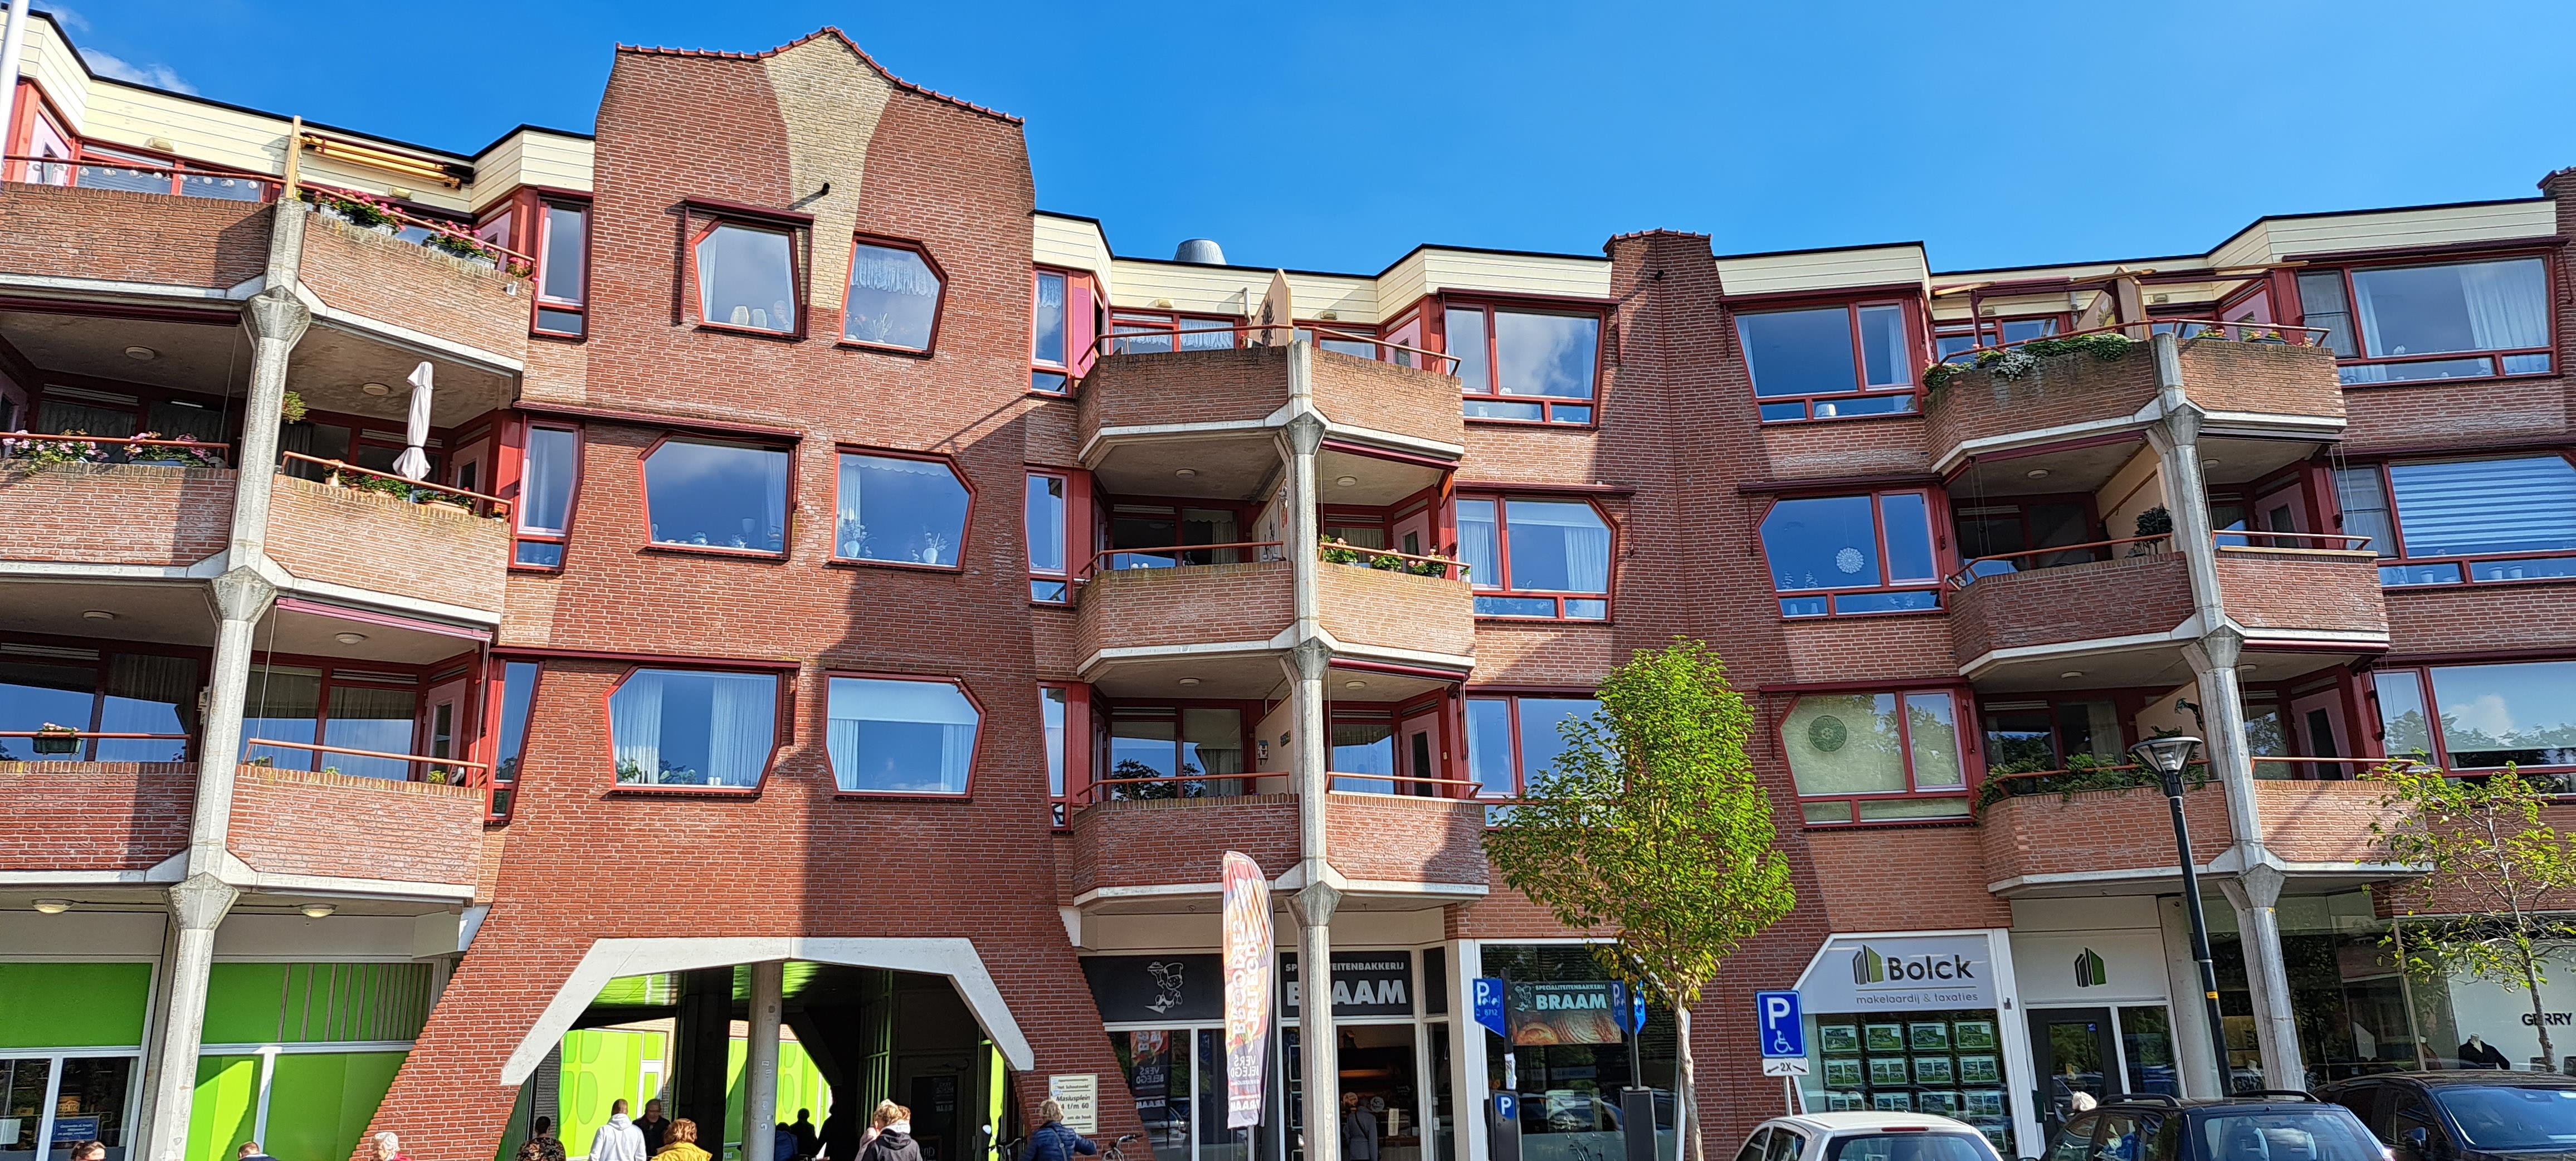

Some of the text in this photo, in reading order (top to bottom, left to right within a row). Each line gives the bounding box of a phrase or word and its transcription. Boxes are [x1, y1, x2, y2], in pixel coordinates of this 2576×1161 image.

[1286, 962, 1404, 972] SPEITENBAKKERIJ
[1887, 954, 1975, 981] Bolck
[1286, 979, 1407, 1006] BAAM
[1477, 982, 1490, 1006] P
[1535, 993, 1607, 1010] BRAAM
[1856, 993, 1978, 1004] makelaardij & taxaties
[1767, 997, 1790, 1030] P
[1780, 1062, 1792, 1072] 2X
[1056, 1094, 1090, 1102] Masiusplein
[1500, 1096, 1512, 1115] P
